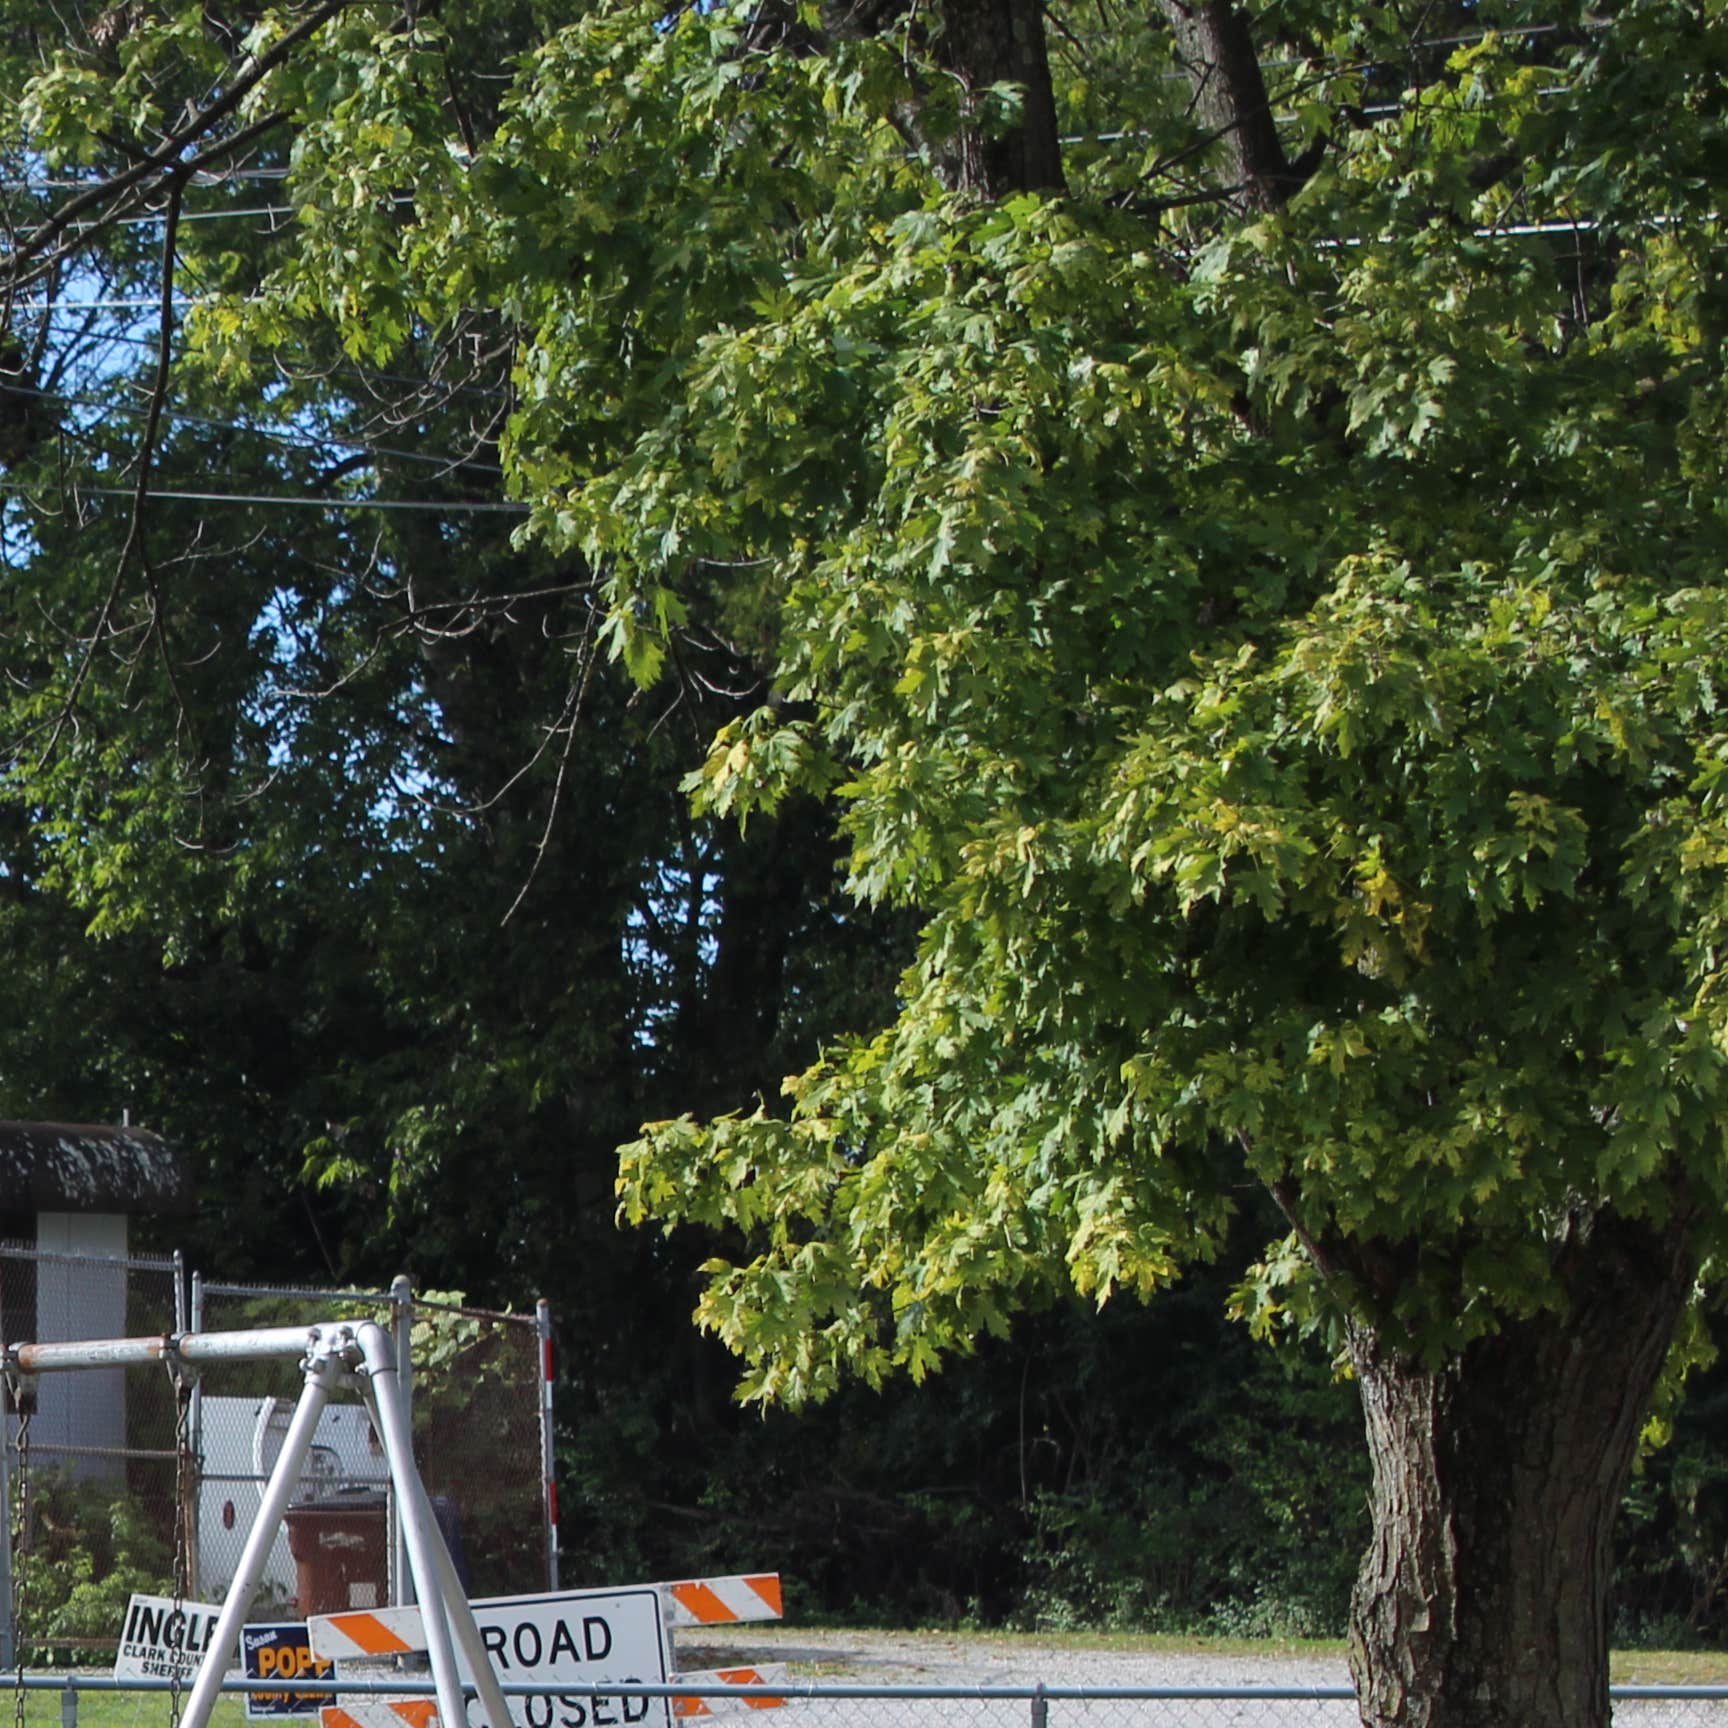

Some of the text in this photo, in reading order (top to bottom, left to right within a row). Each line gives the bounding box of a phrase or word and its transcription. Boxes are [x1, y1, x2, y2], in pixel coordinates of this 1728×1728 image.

[245, 1630, 279, 1651] Susan
[479, 1615, 613, 1670] ROAD
[123, 1644, 166, 1662] CLARK
